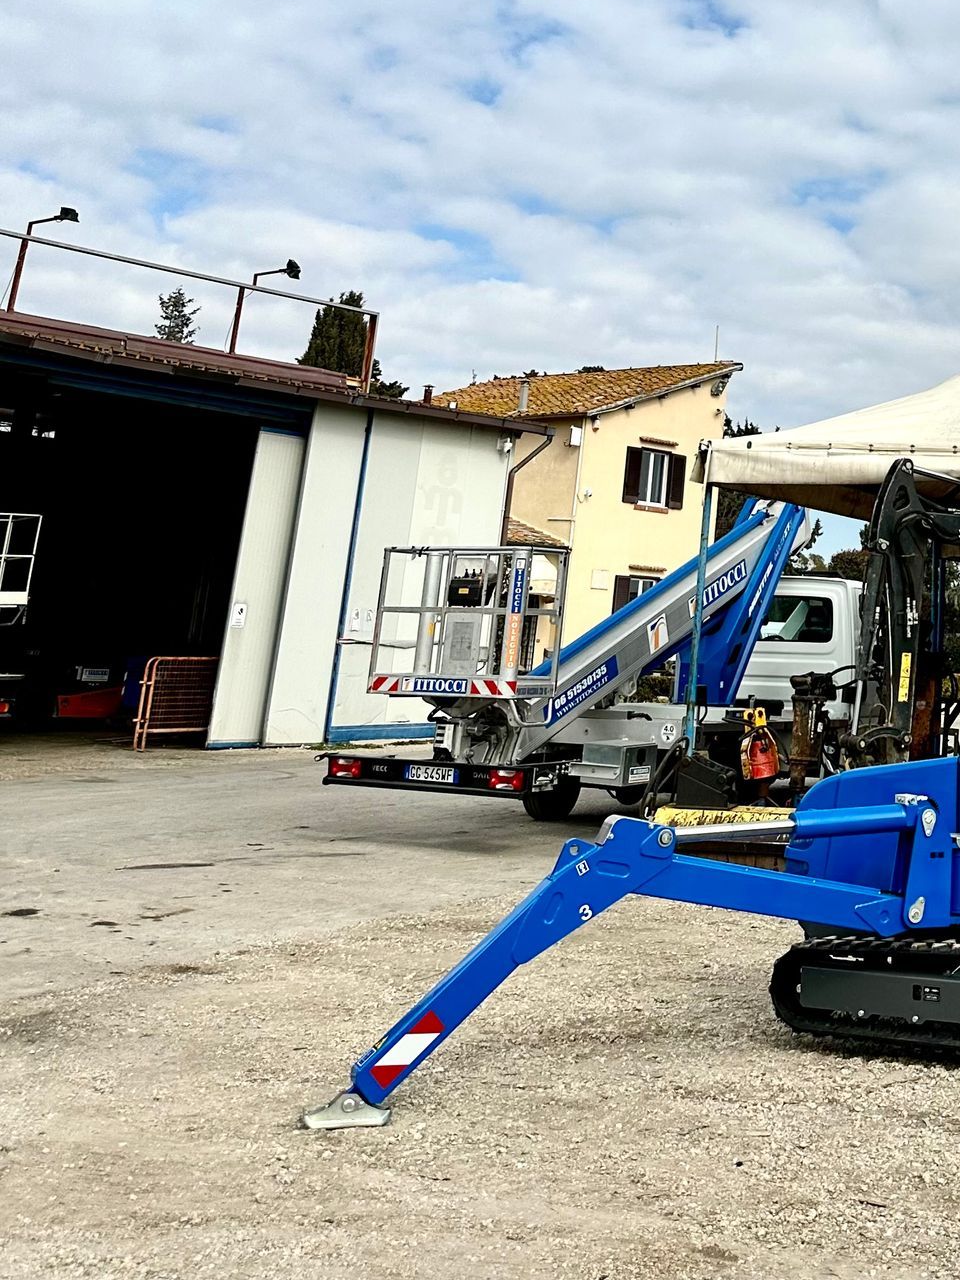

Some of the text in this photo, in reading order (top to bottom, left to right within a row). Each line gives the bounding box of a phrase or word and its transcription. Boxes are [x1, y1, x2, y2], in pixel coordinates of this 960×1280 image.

[514, 569, 523, 613] TITOCCI
[415, 679, 467, 693] TITOCCI
[554, 664, 607, 709] 06 51530135
[423, 767, 452, 781] 545WF
[579, 904, 593, 921] 3
